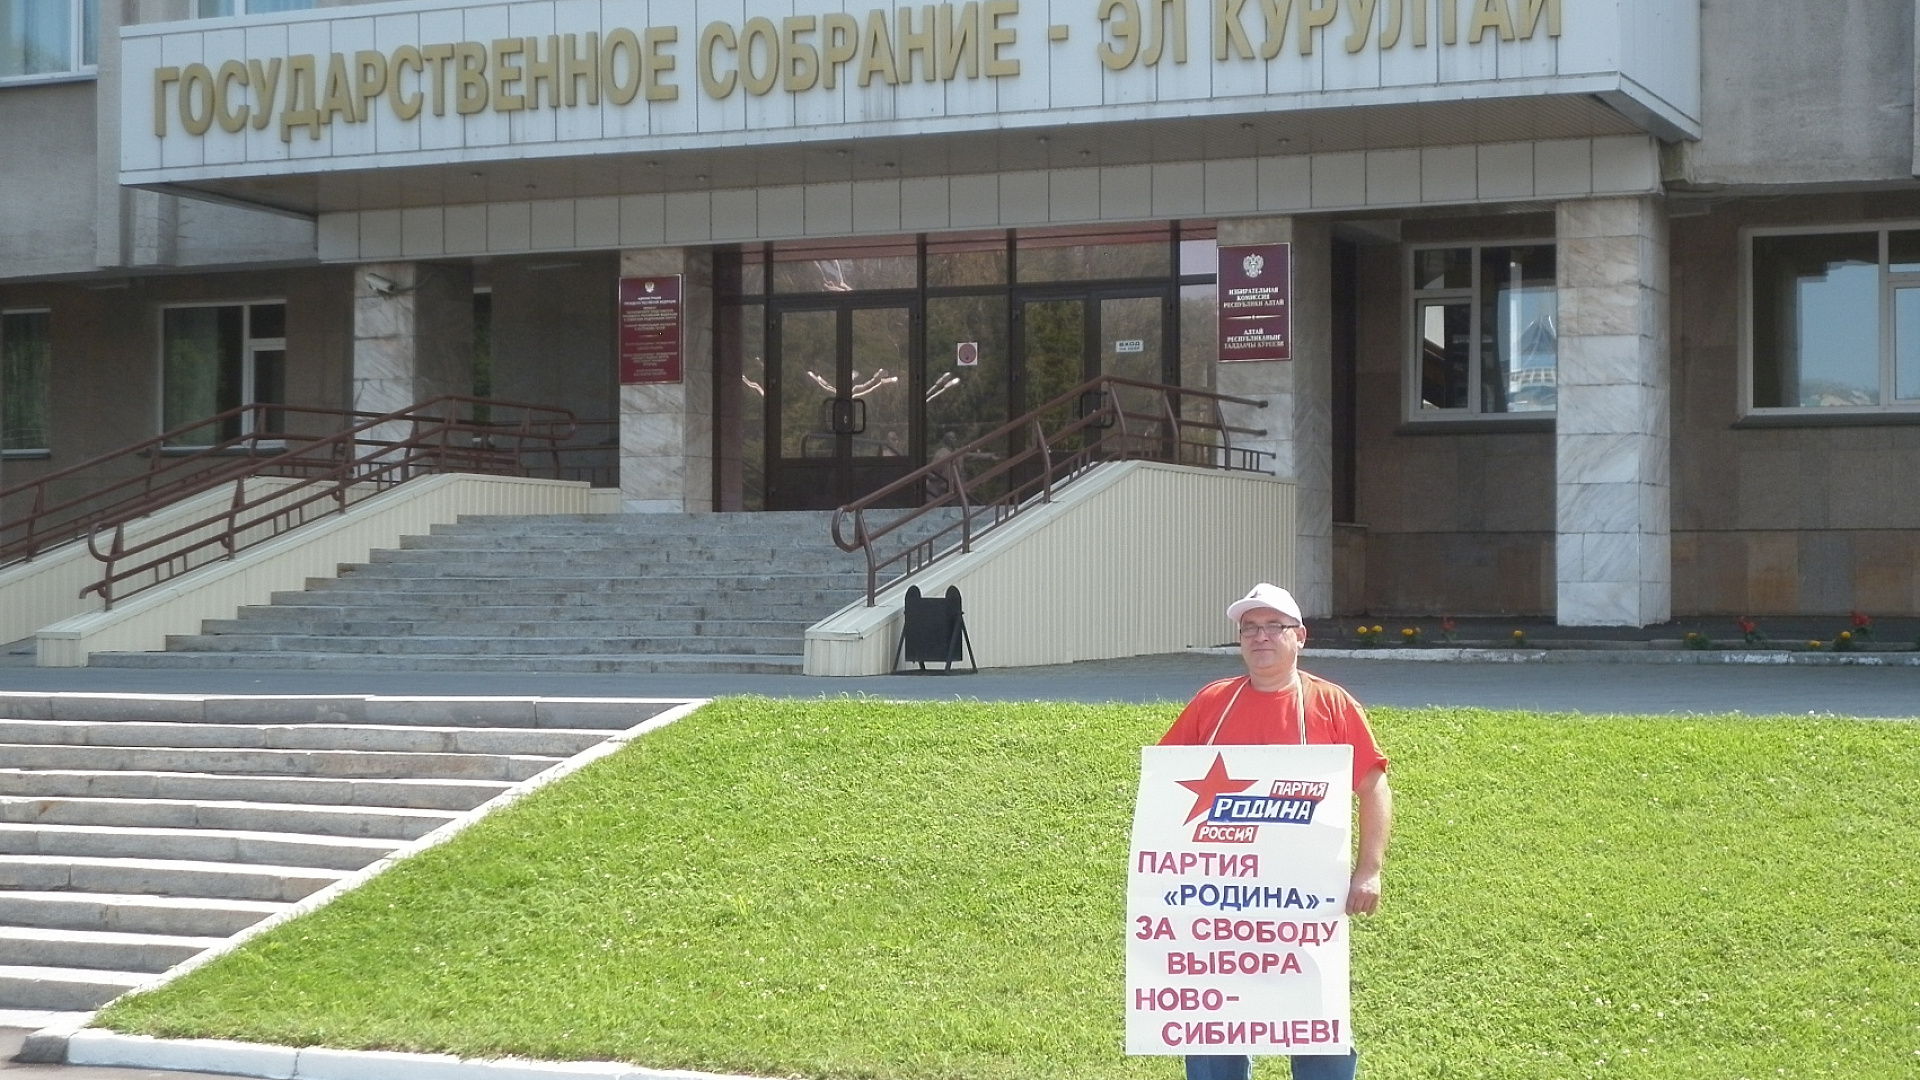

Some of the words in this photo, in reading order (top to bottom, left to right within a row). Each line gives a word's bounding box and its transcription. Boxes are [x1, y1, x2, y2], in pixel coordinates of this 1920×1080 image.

[154, 25, 679, 143] ГОСУДАРСТВЕННОЕ
[701, 0, 1021, 99] СОБРАНИЕ
[1098, 0, 1188, 70] ЭЛ
[1228, 287, 1279, 295] ИЗБИРАТЕЛЬНАЯ
[1264, 299, 1285, 307] АЛТАЙ
[1272, 782, 1327, 798] ПАРТИЯ
[1214, 798, 1312, 820] РОДИНА
[1198, 826, 1254, 842] РОССИЯ
[1137, 851, 1259, 877] ПАРТИЯ
[1135, 916, 1176, 941] ЗА
[1191, 918, 1338, 947] СВОБОДУ
[1167, 951, 1302, 975] ВЫБОРА
[1135, 988, 1240, 1011] НОВО-
[1161, 1019, 1340, 1048] СИБИРЦЕВ!
